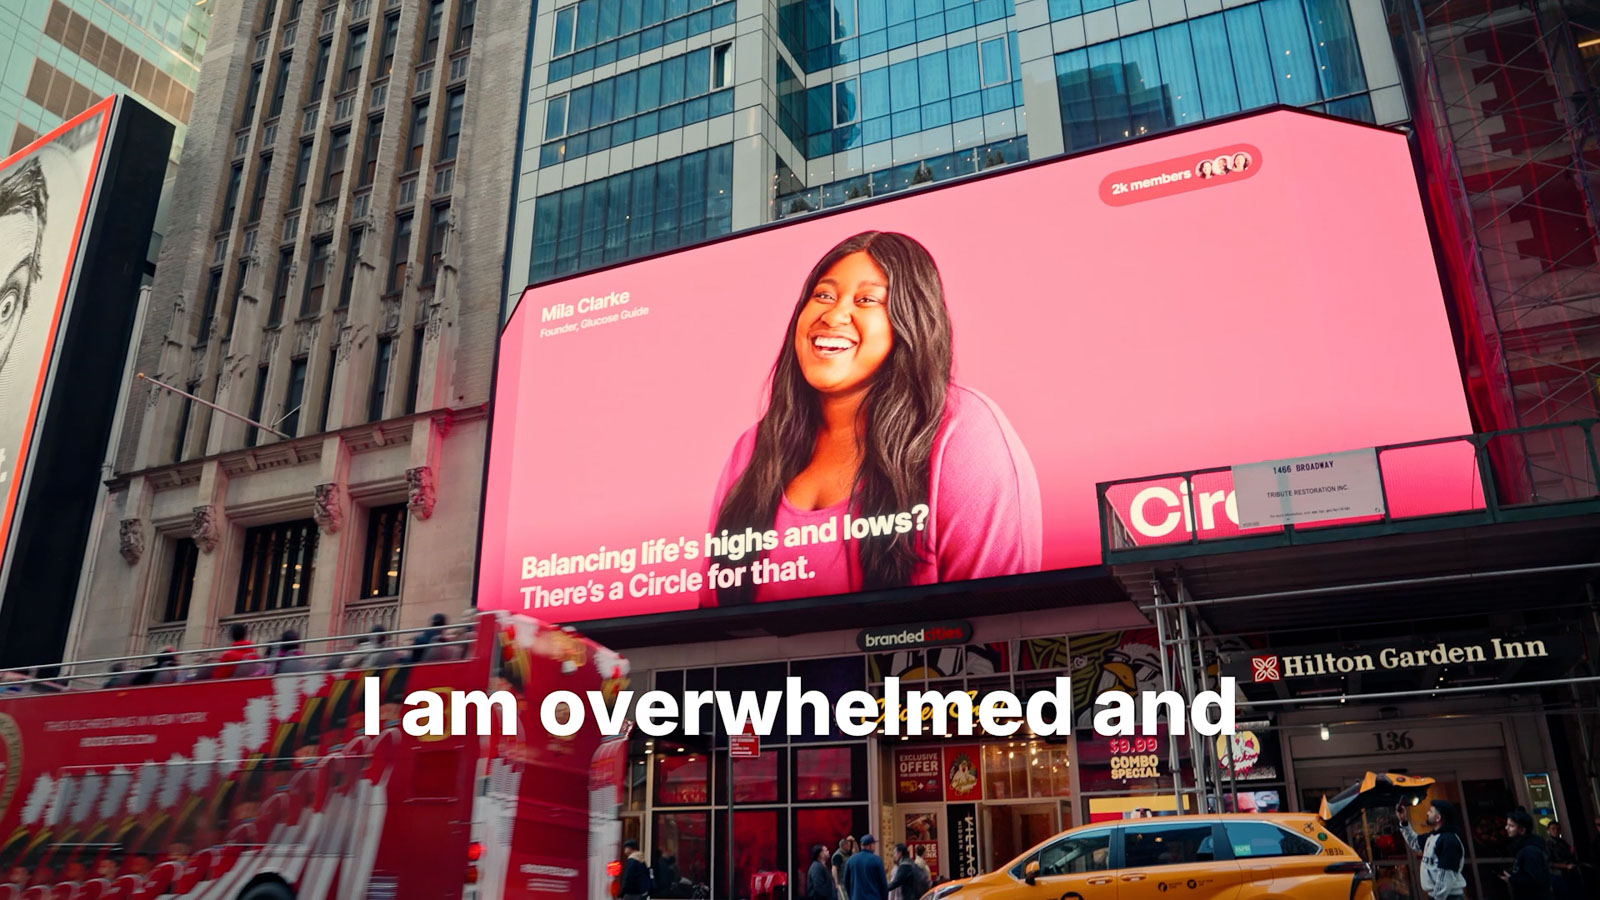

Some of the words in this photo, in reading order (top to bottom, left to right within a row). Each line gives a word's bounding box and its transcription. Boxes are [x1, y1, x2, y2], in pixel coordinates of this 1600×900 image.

[1111, 182, 1128, 195] 2k
[1130, 169, 1192, 192] members
[541, 303, 575, 323] Mila
[577, 291, 631, 314] Clarke
[540, 323, 579, 338] Founder,
[580, 313, 619, 329] Glucose
[620, 306, 650, 320] Guide
[1273, 465, 1292, 474] 1466
[1296, 461, 1334, 472] BROADWAY
[1267, 490, 1293, 499] TRIBUTE
[1293, 486, 1336, 496] RESTORATION
[1130, 480, 1239, 537] Cir
[521, 546, 636, 580] Balancing
[641, 536, 699, 565] life's
[704, 526, 779, 561] highs
[784, 516, 837, 546] and
[843, 503, 930, 541] lows?
[520, 579, 605, 610] There's
[608, 581, 624, 601] a
[629, 568, 703, 599] Circle
[707, 563, 747, 590] for
[751, 555, 816, 586] that.
[1282, 653, 1376, 677] Hilton
[1379, 643, 1487, 669] Garden
[1491, 638, 1548, 660] Inn
[1109, 736, 1158, 754] $9.99
[1372, 731, 1415, 751] 136
[899, 753, 938, 762] EXCLUSIVE
[899, 761, 939, 773] OFFER
[1110, 754, 1159, 769] COMBO
[1111, 767, 1161, 780] SPECIAL
